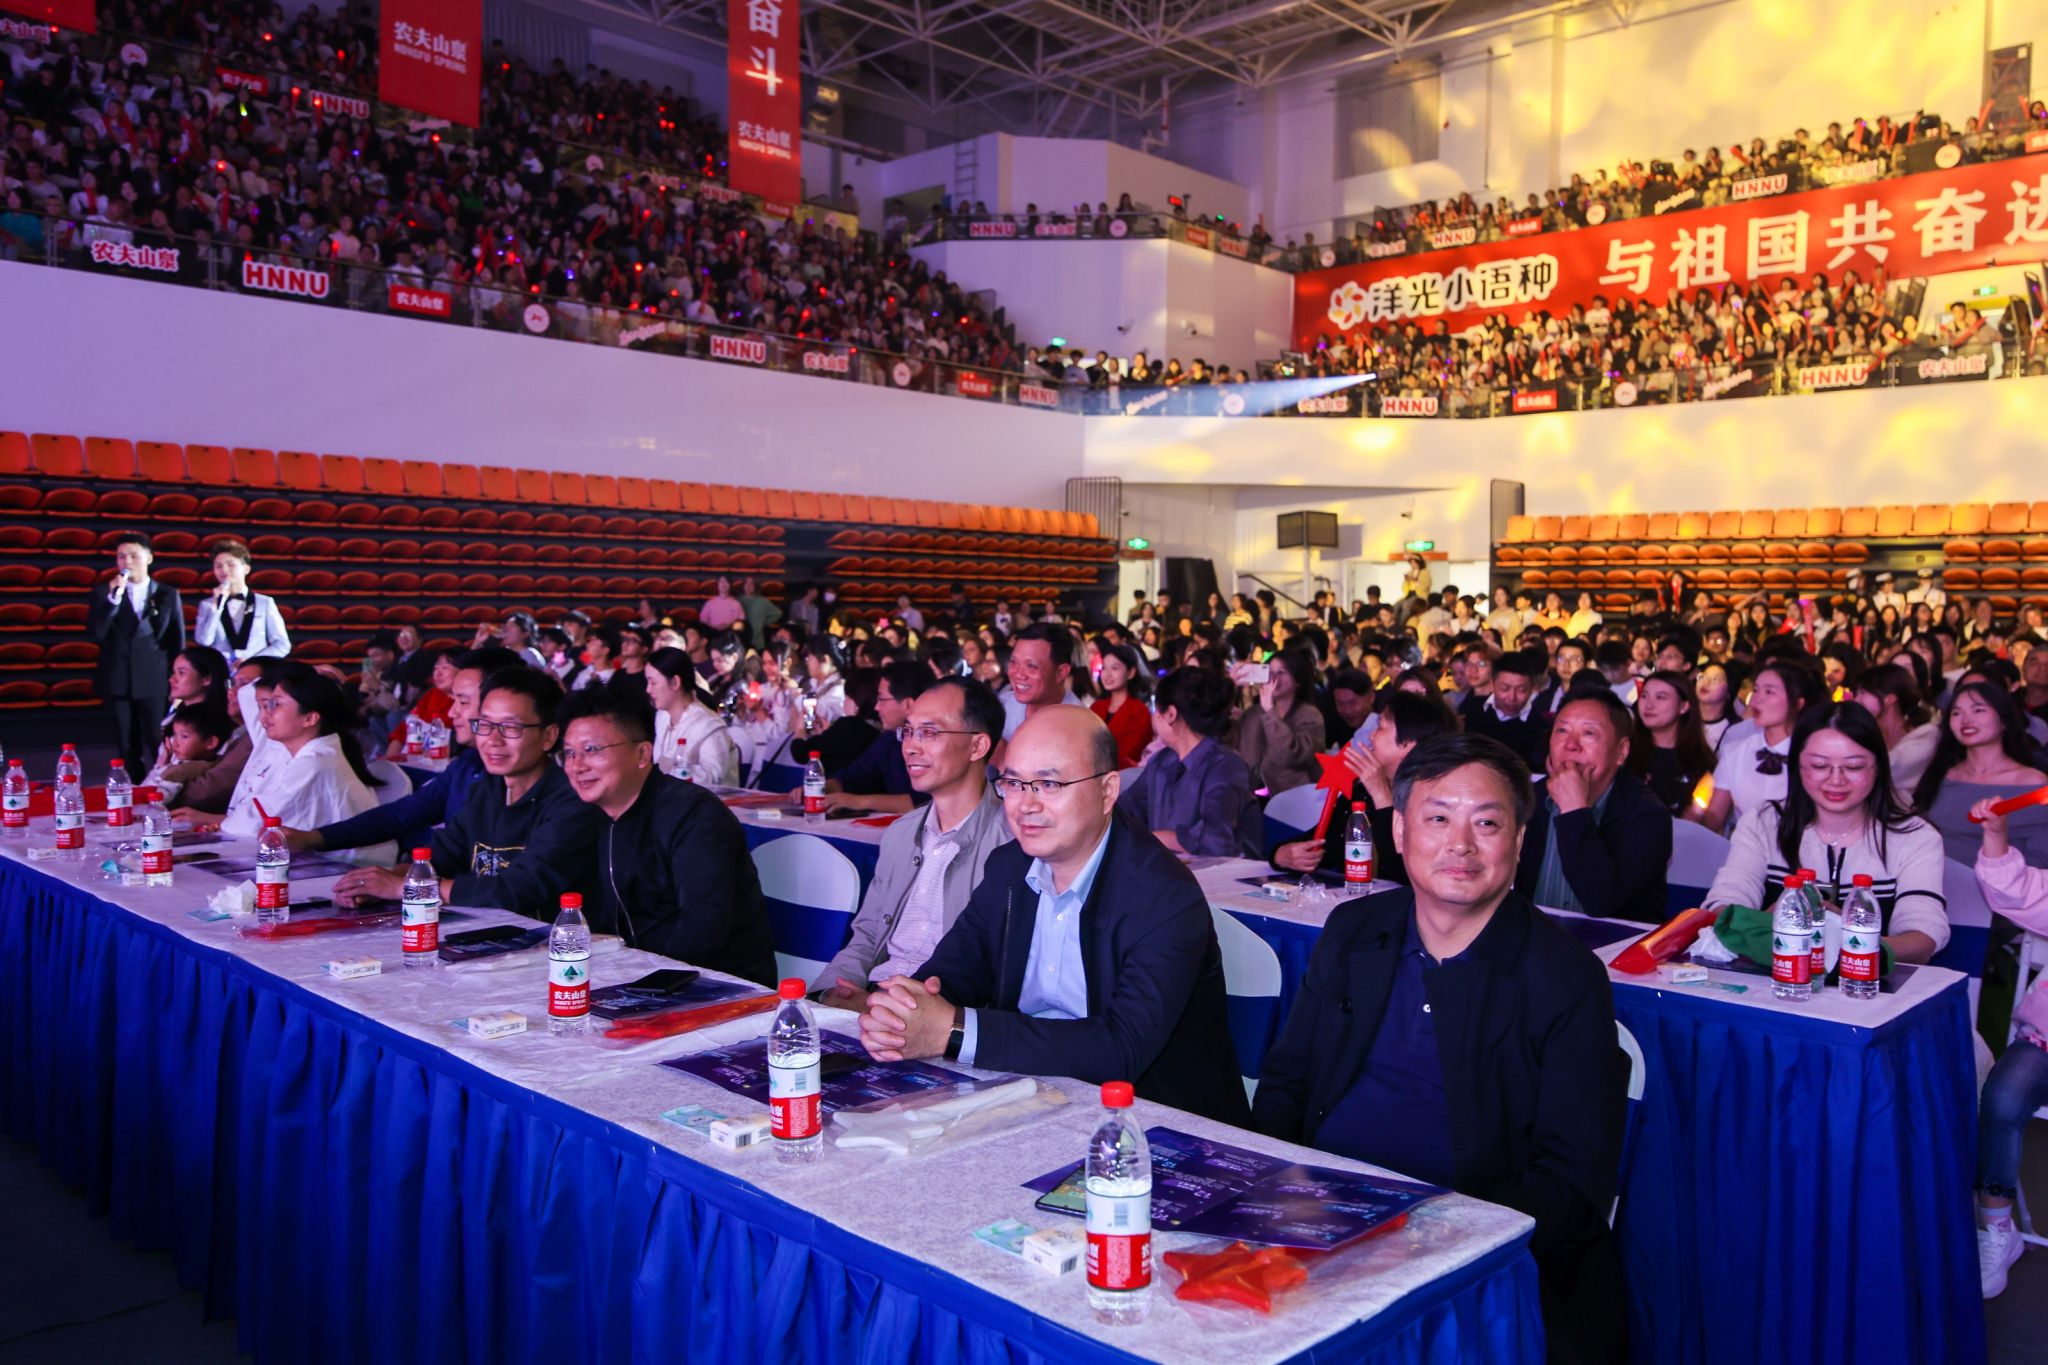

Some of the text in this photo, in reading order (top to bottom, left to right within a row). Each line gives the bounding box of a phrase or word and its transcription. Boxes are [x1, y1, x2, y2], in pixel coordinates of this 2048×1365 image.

[394, 21, 468, 63] 农夫山泉
[738, 121, 792, 149] 农夫山泉
[1734, 176, 1787, 199] HNNU
[971, 223, 1015, 236] HNNU
[95, 242, 179, 270] 农夫山泉
[245, 263, 327, 296] HNNU
[1372, 261, 1554, 317] 洋光小语种
[711, 338, 767, 362] HNNU
[1801, 365, 1867, 387] HNNU
[1384, 399, 1437, 414] HNNU
